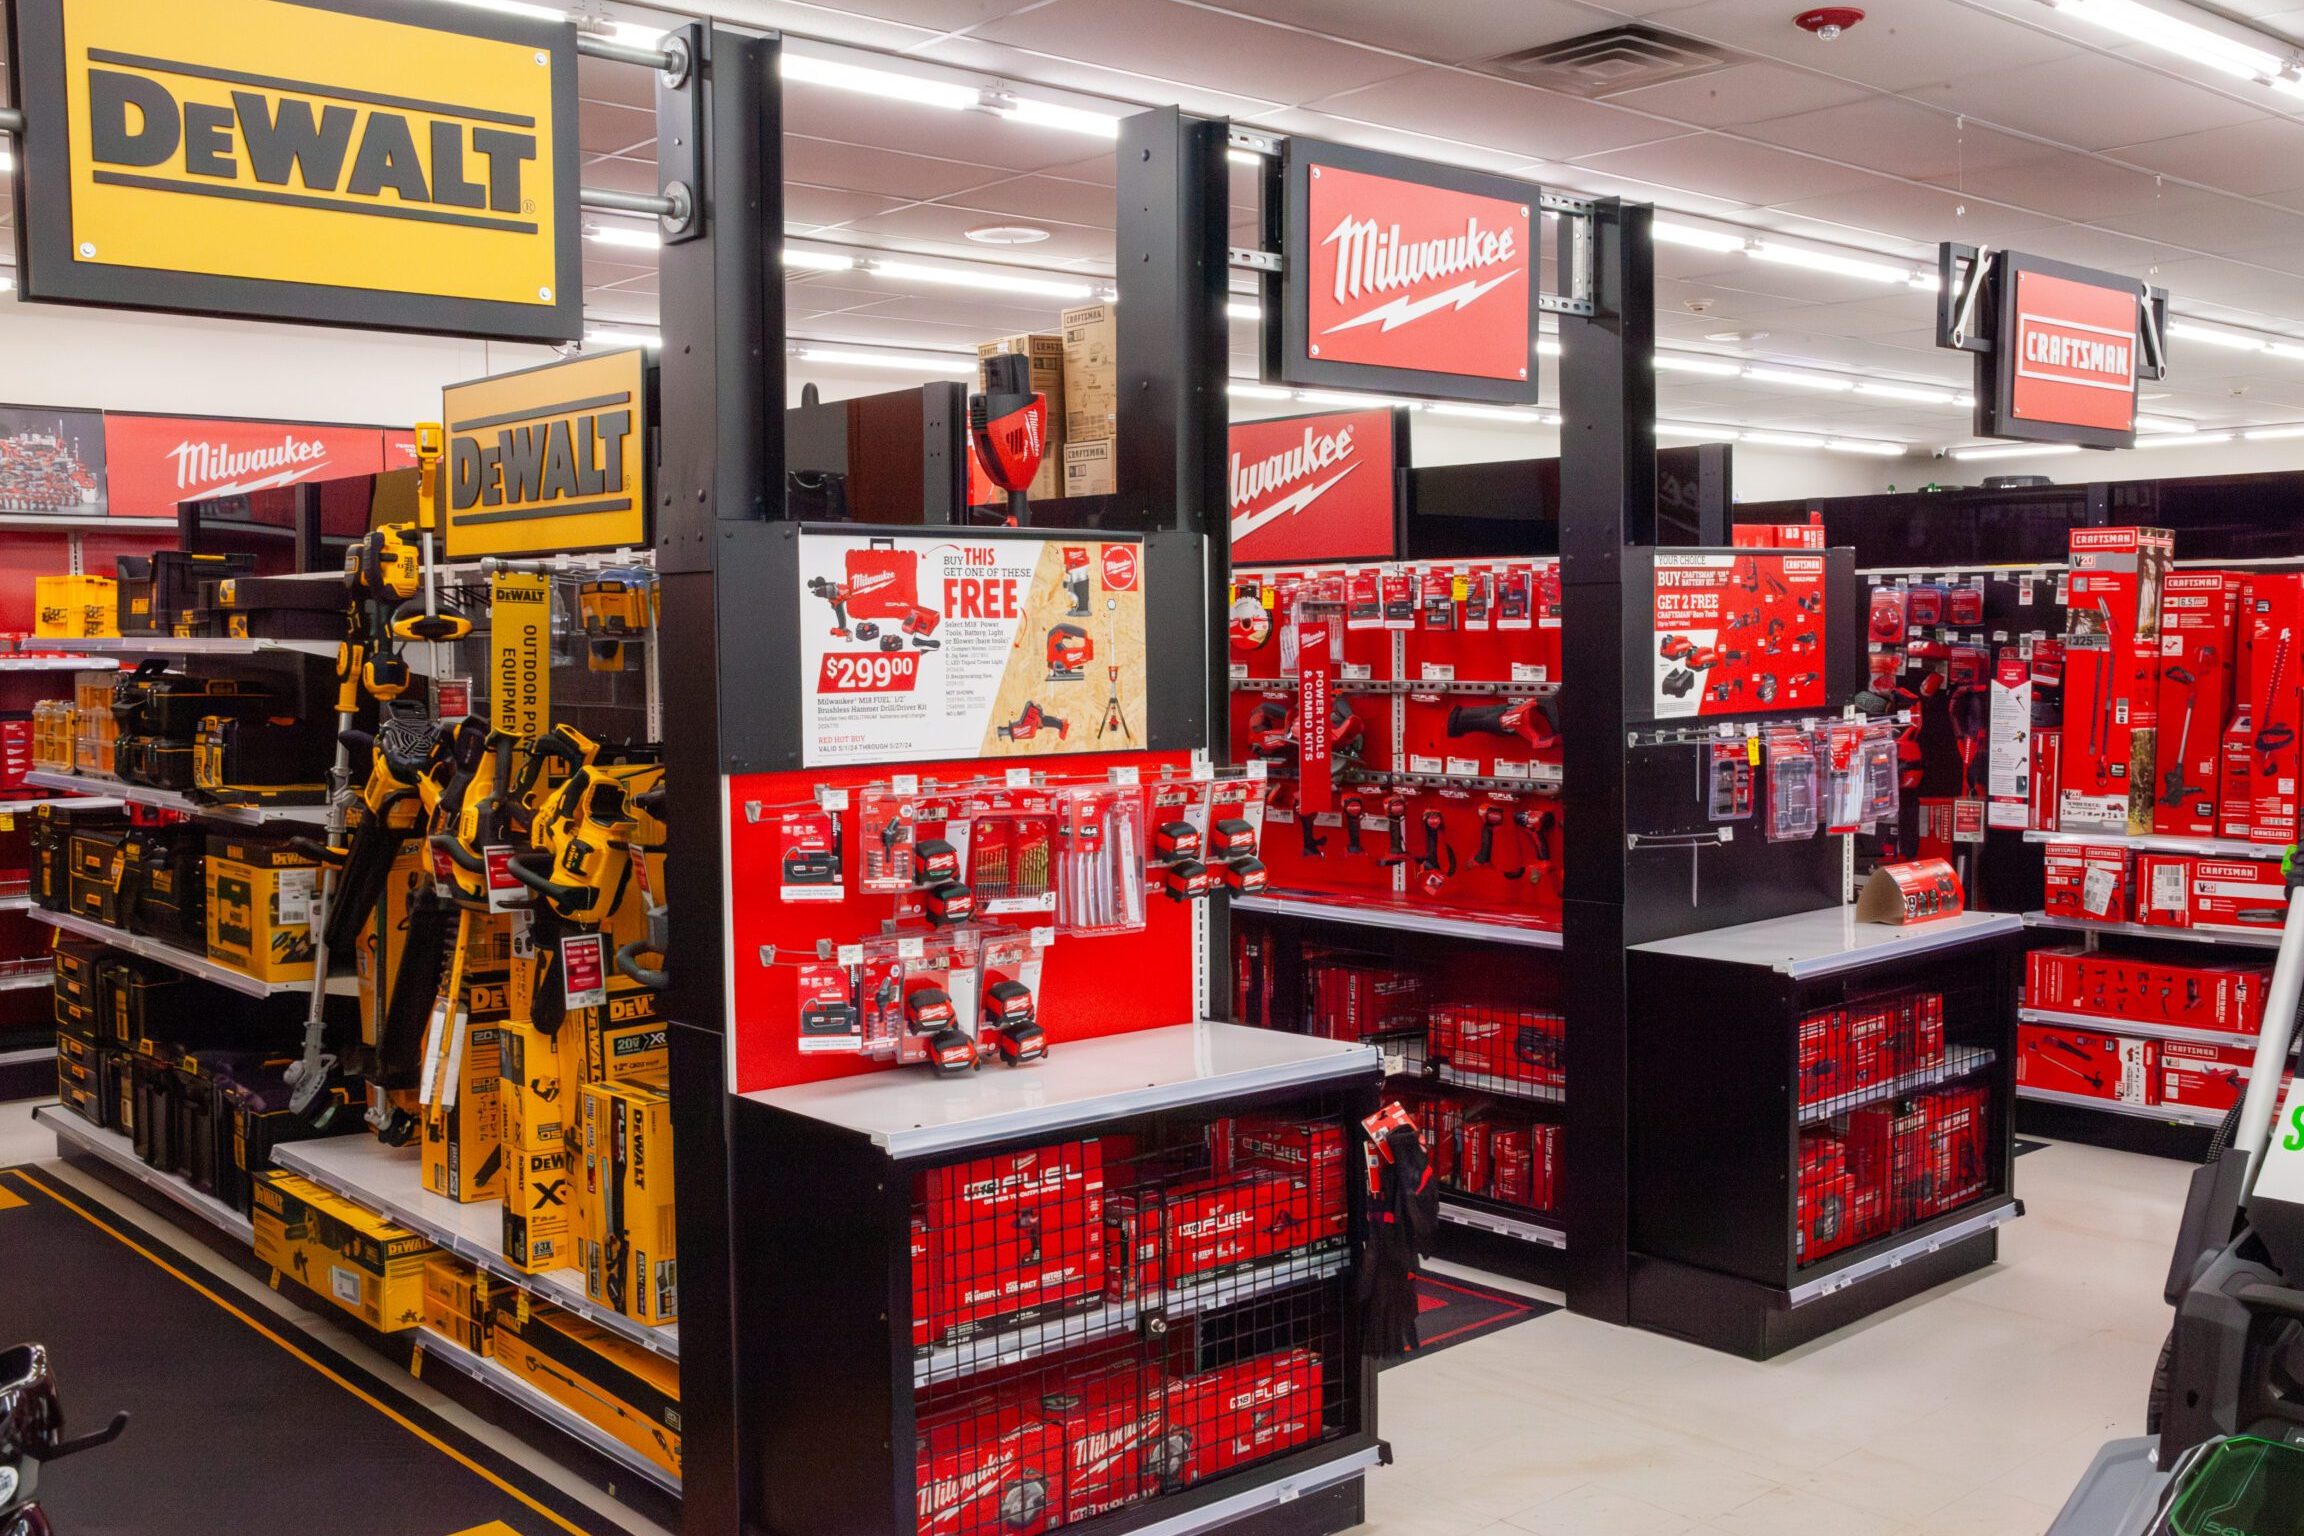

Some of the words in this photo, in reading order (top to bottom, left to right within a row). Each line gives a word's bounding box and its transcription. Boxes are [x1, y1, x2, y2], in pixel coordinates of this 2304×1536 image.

[88, 67, 537, 214] DEWALT
[1320, 212, 1516, 305] Milwaukee
[1066, 309, 1102, 325] CRAFTSMAN
[2026, 330, 2129, 376] CRAFTSMAN
[1027, 409, 1041, 458] Milwaukee
[165, 435, 327, 489] Milwaukee
[451, 409, 632, 511] DEWALT
[1067, 446, 1105, 460] CRAFTSMAN
[1231, 426, 1355, 509] lwaukee
[2076, 534, 2131, 544] CRAFTSMAN
[943, 556, 964, 566] BUY
[964, 547, 996, 566] THIS
[1658, 556, 1678, 566] YOUR
[1679, 556, 1706, 565] CHOICE
[1786, 560, 1820, 570] CRAFTSMAN
[944, 568, 962, 577] GET
[964, 568, 985, 577] ONE
[986, 568, 1000, 577] OF
[1000, 568, 1032, 578] THESE
[1658, 571, 1681, 586] BUY
[2168, 579, 2218, 588] CRAFTSMAN
[496, 589, 545, 602] DEWALT
[944, 578, 1018, 619] FREE
[1657, 594, 1680, 610] GET
[1682, 594, 1689, 609] 2
[1690, 594, 1719, 609] FREE
[523, 624, 537, 705] OUTDOOR
[1304, 670, 1313, 679] &
[502, 648, 516, 733] EQUIPMEN
[1316, 670, 1324, 714] POWER
[818, 706, 850, 714] Brushless
[1304, 682, 1313, 728] COMBO
[1304, 732, 1313, 762] KITS
[1316, 718, 1324, 760] TOOLS
[2201, 866, 2255, 877] CRAFTSMAN
[470, 986, 510, 1010] DE
[610, 996, 655, 1020] DEW
[2168, 1044, 2215, 1057] CRAFTSMAN
[633, 1108, 645, 1191] DEWALT
[531, 1154, 566, 1172] DEW
[1002, 1164, 1082, 1193] FUEL
[1203, 1210, 1254, 1232] FUEL
[387, 1237, 437, 1256] DEWAL
[1072, 1410, 1160, 1470] Milwauee
